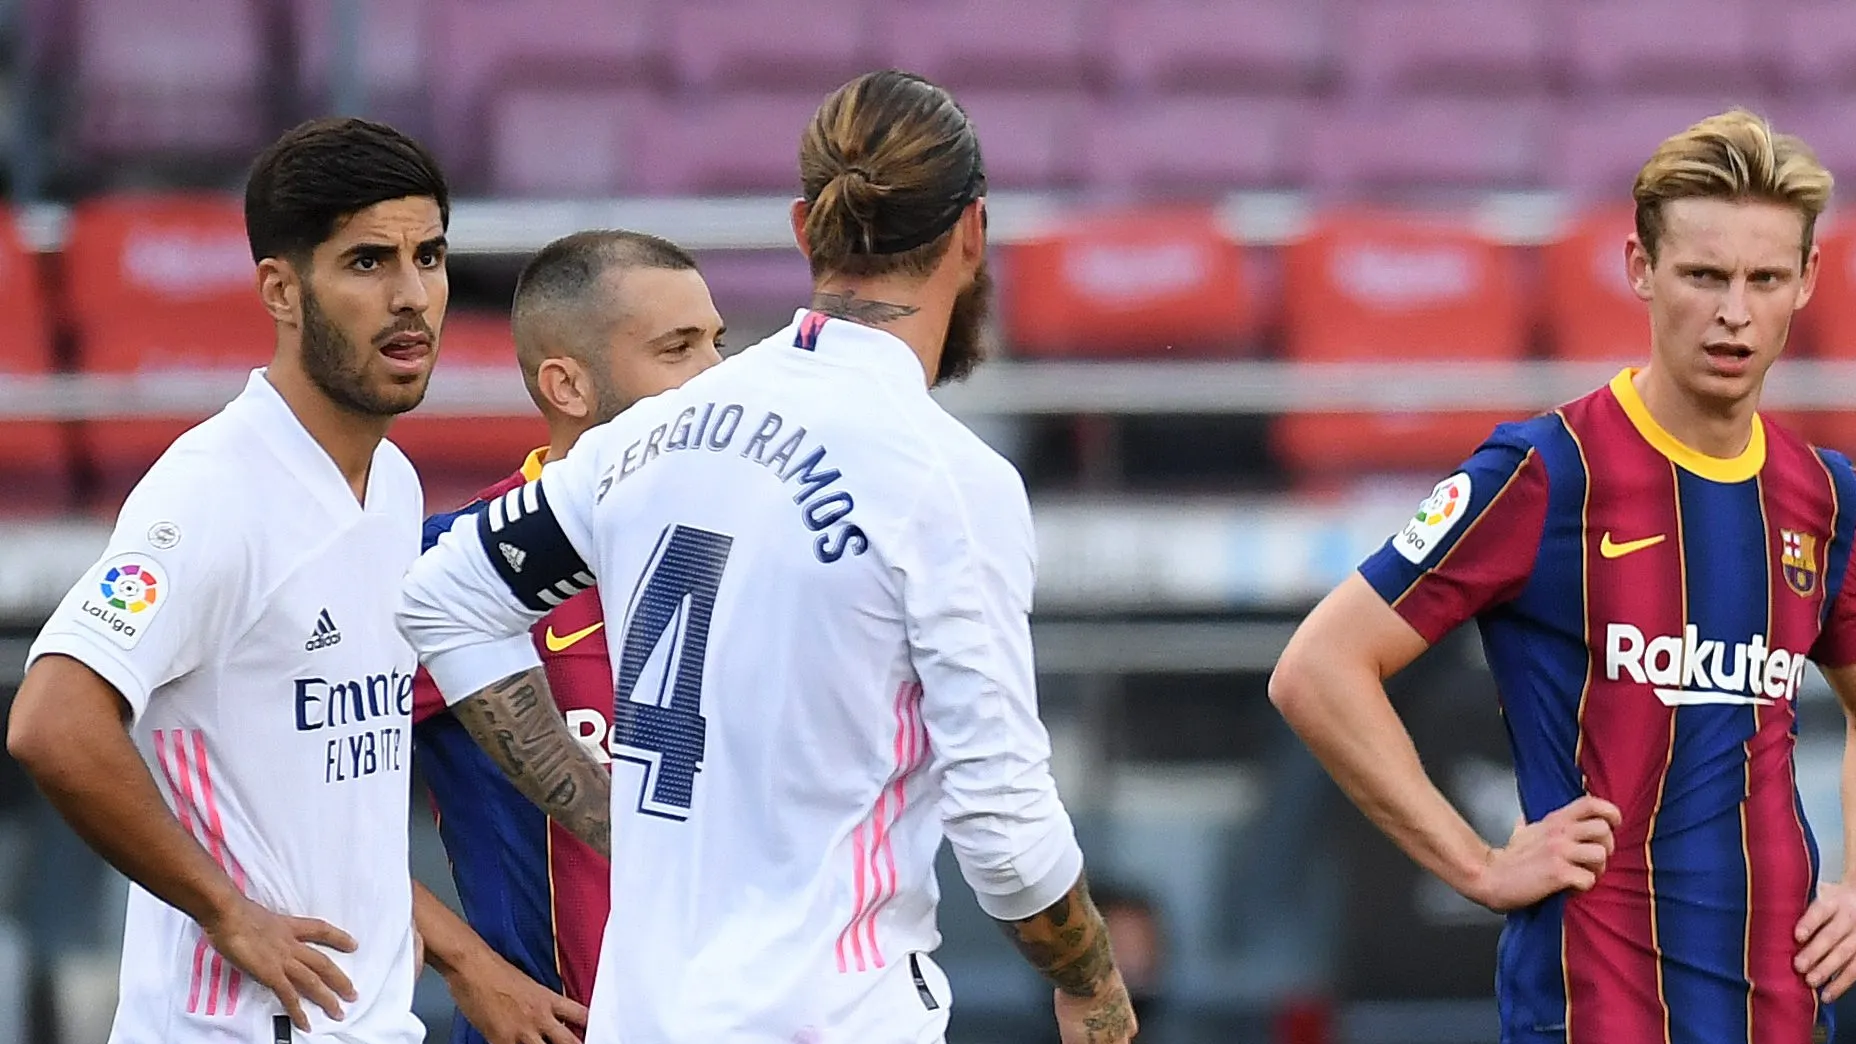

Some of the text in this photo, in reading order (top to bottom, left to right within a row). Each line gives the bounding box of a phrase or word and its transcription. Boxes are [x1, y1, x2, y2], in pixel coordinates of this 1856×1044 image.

[597, 402, 869, 564] SERGIO RAMOS
[82, 600, 136, 637] LaLiga
[611, 523, 734, 822] 4
